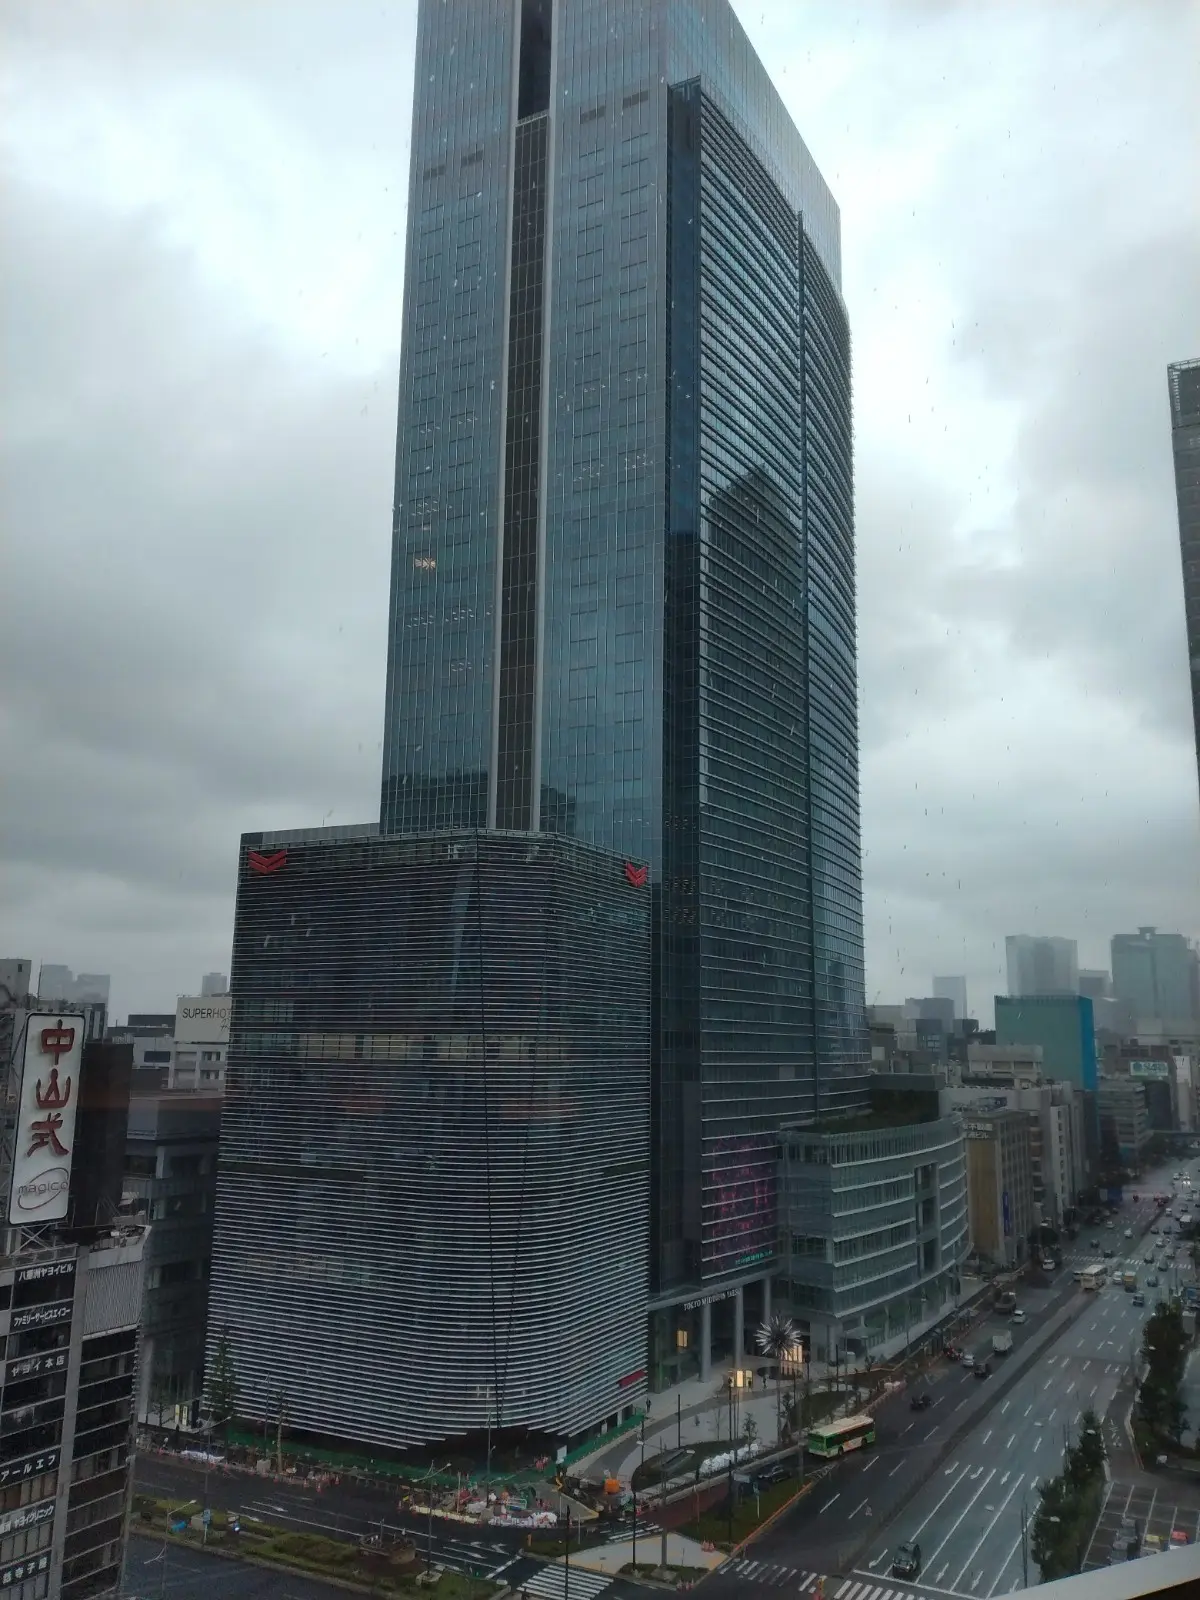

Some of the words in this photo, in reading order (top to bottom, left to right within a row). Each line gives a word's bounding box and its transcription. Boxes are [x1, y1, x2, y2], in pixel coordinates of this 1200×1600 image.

[27, 1019, 75, 1157] 中山式
[18, 1181, 68, 1195] magico
[684, 1300, 701, 1311] TOKYO
[12, 1355, 65, 1377] ヤヨイ本店
[1, 1454, 56, 1480] アールエフ
